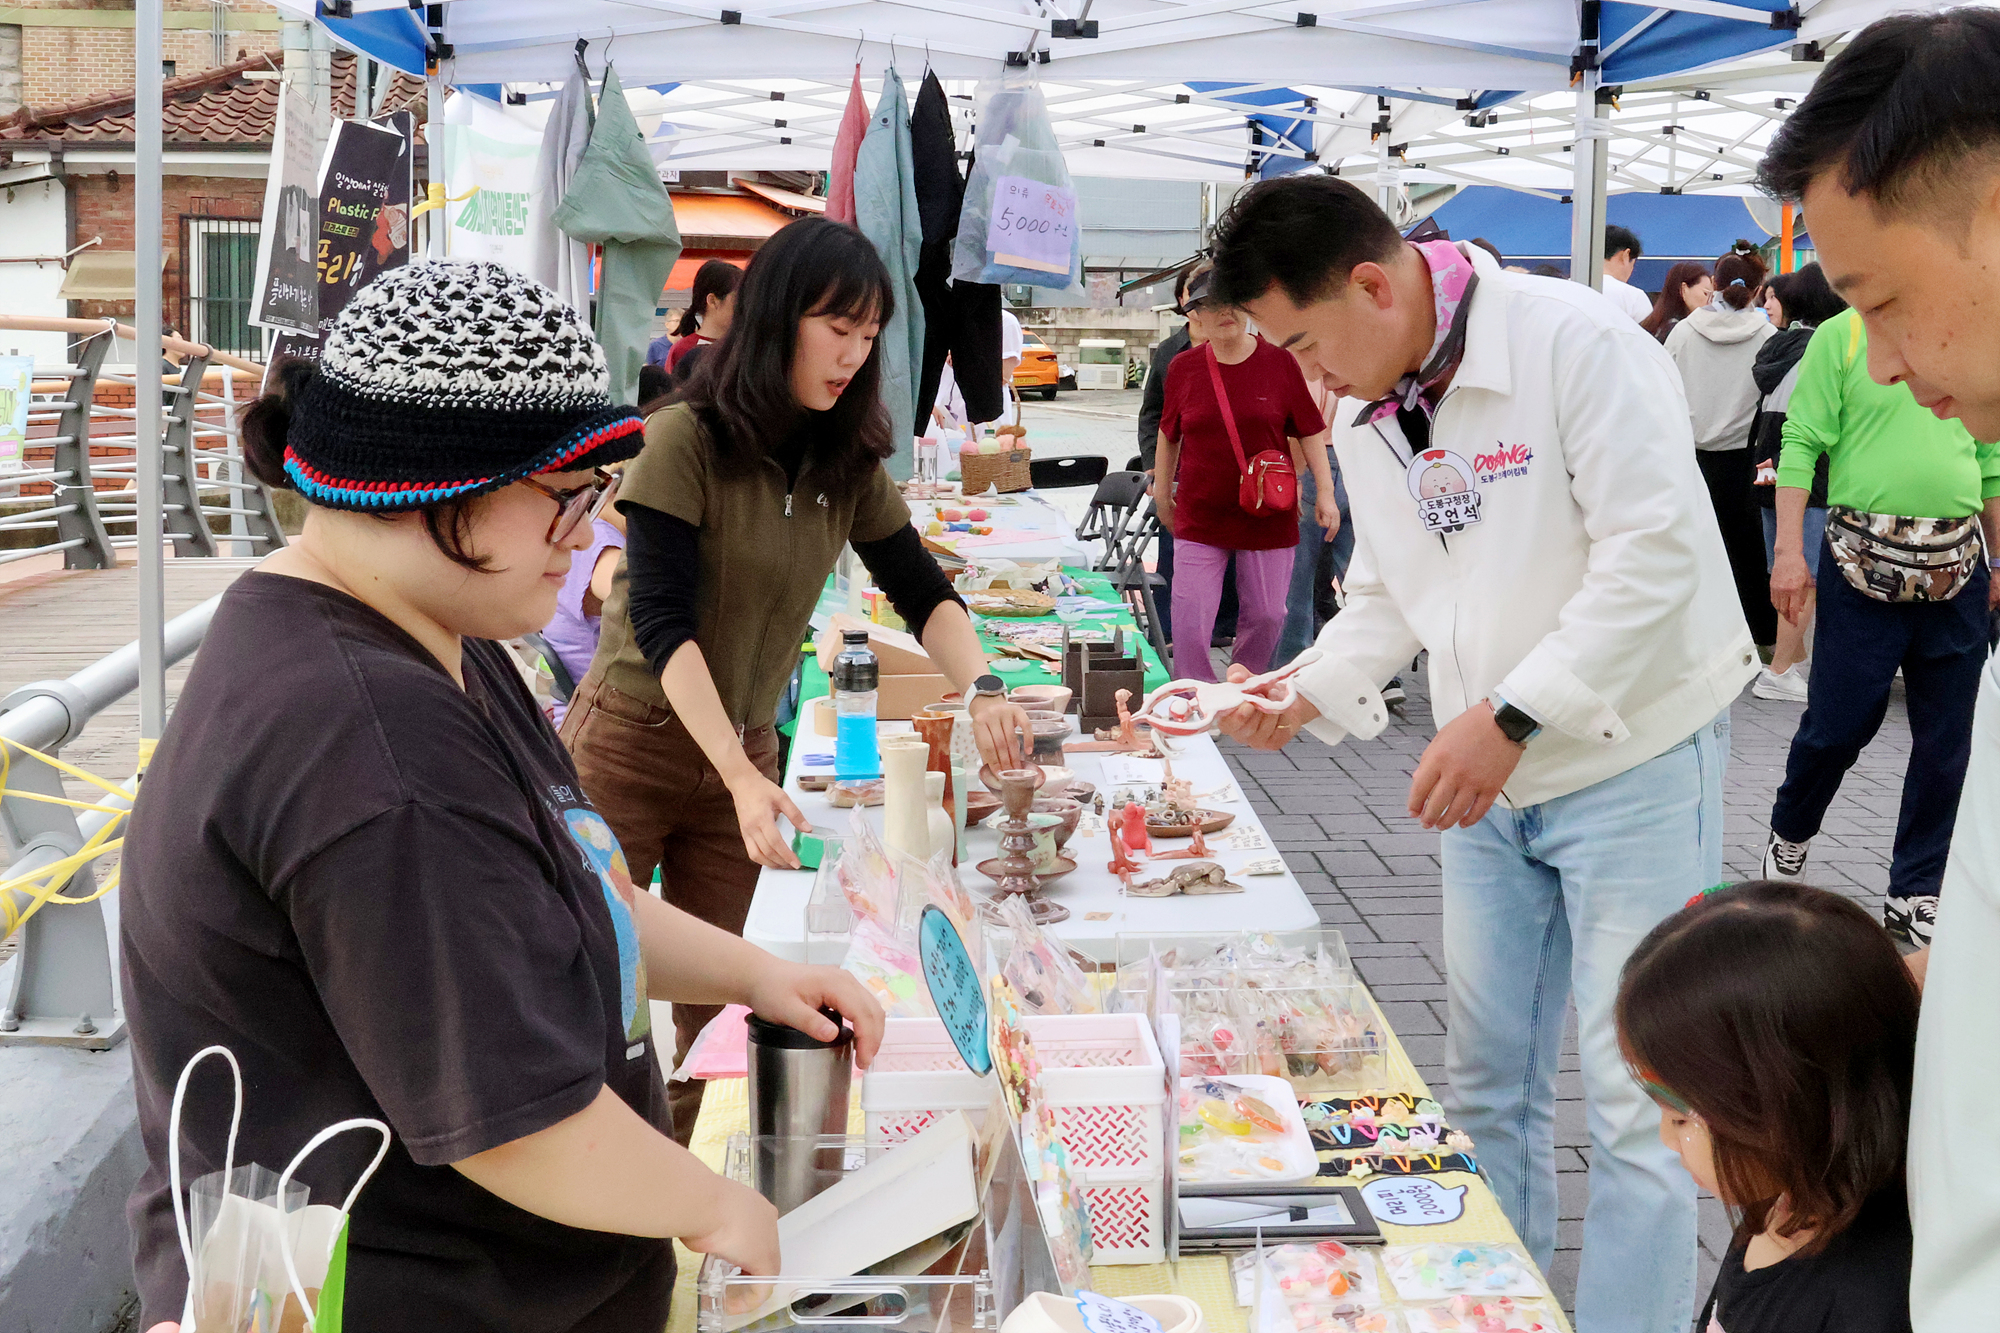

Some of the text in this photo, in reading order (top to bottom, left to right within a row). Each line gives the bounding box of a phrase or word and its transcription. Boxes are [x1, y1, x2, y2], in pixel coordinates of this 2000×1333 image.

[335, 172, 371, 191] 일상에서
[1009, 184, 1029, 199] 의류
[327, 197, 370, 219] Plastic
[1427, 493, 1470, 510] 도봉구청장
